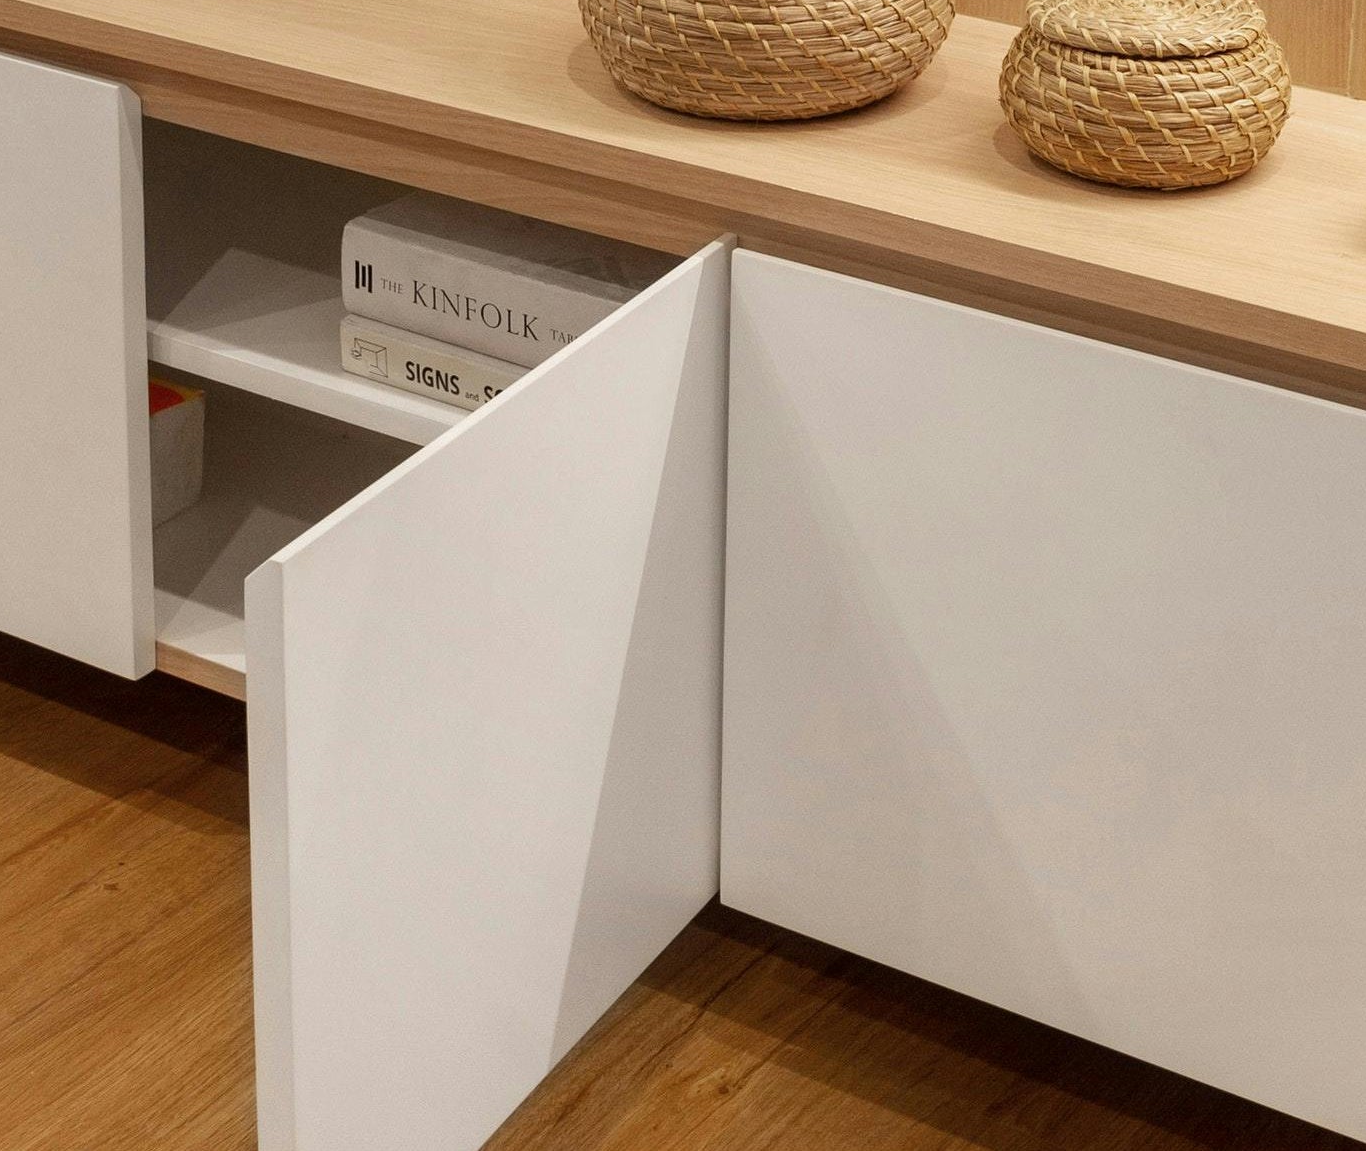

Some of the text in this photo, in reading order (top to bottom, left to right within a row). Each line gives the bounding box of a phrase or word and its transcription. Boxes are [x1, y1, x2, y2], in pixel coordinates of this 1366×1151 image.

[381, 277, 578, 345] THE KINFOLK TAB
[405, 360, 461, 396] SIGNS
[465, 391, 480, 402] and
